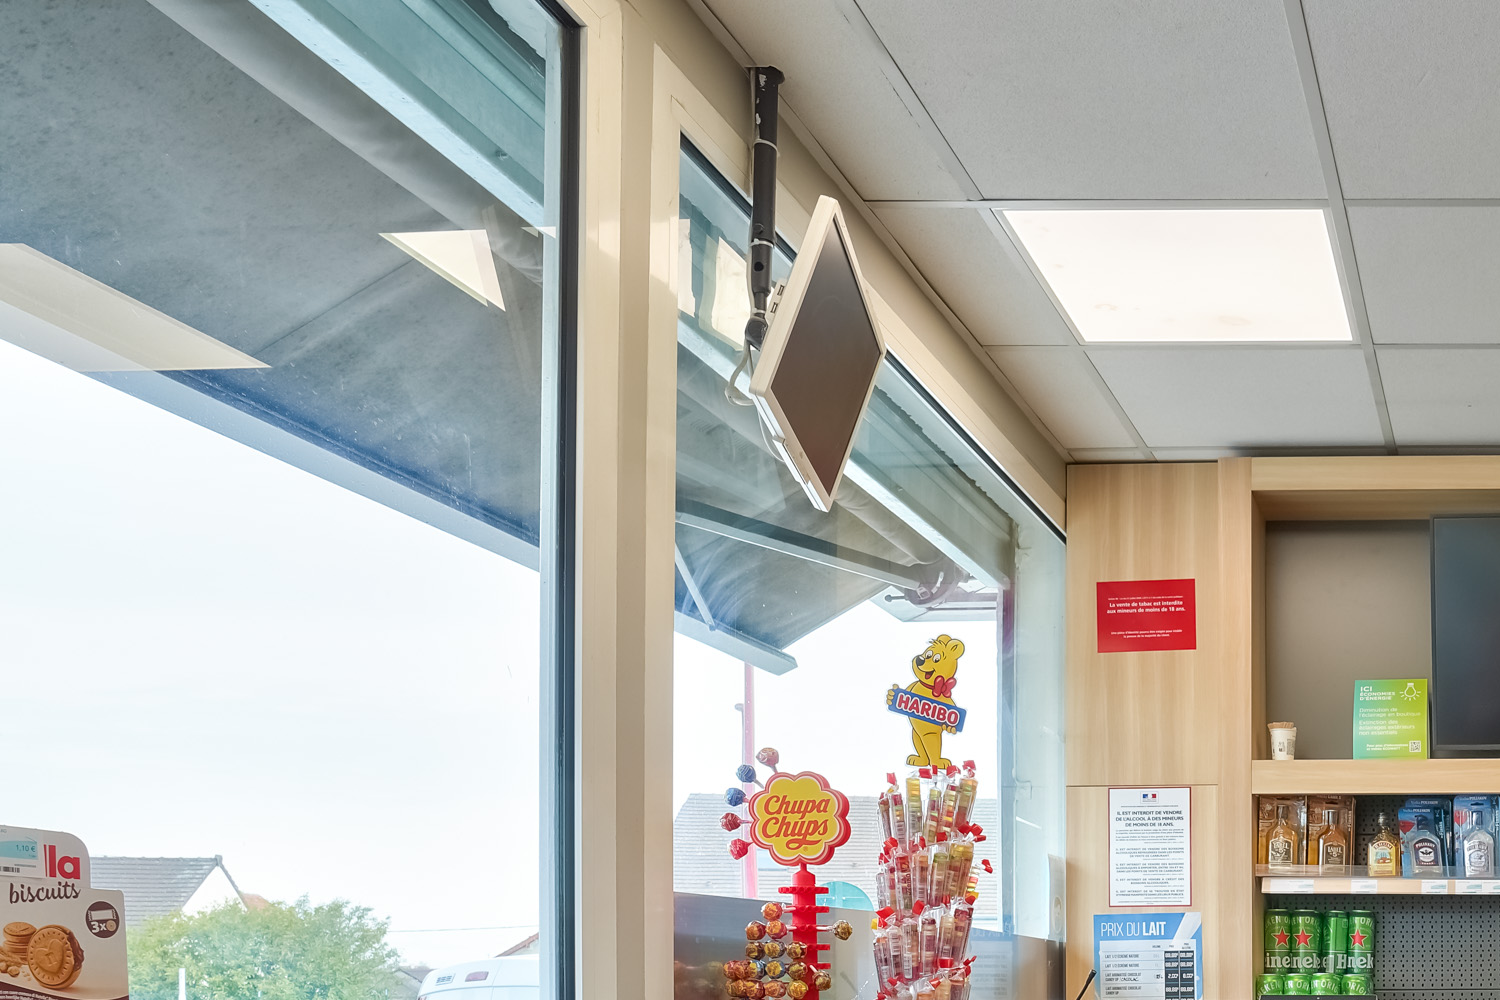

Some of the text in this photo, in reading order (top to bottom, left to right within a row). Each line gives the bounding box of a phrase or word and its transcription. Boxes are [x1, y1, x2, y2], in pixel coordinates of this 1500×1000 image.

[896, 694, 959, 726] HARIBO
[764, 795, 830, 818] Chupa
[762, 817, 828, 849] Chups
[9, 881, 81, 904] biscuits
[1101, 921, 1166, 936] PRIX DU LAIT
